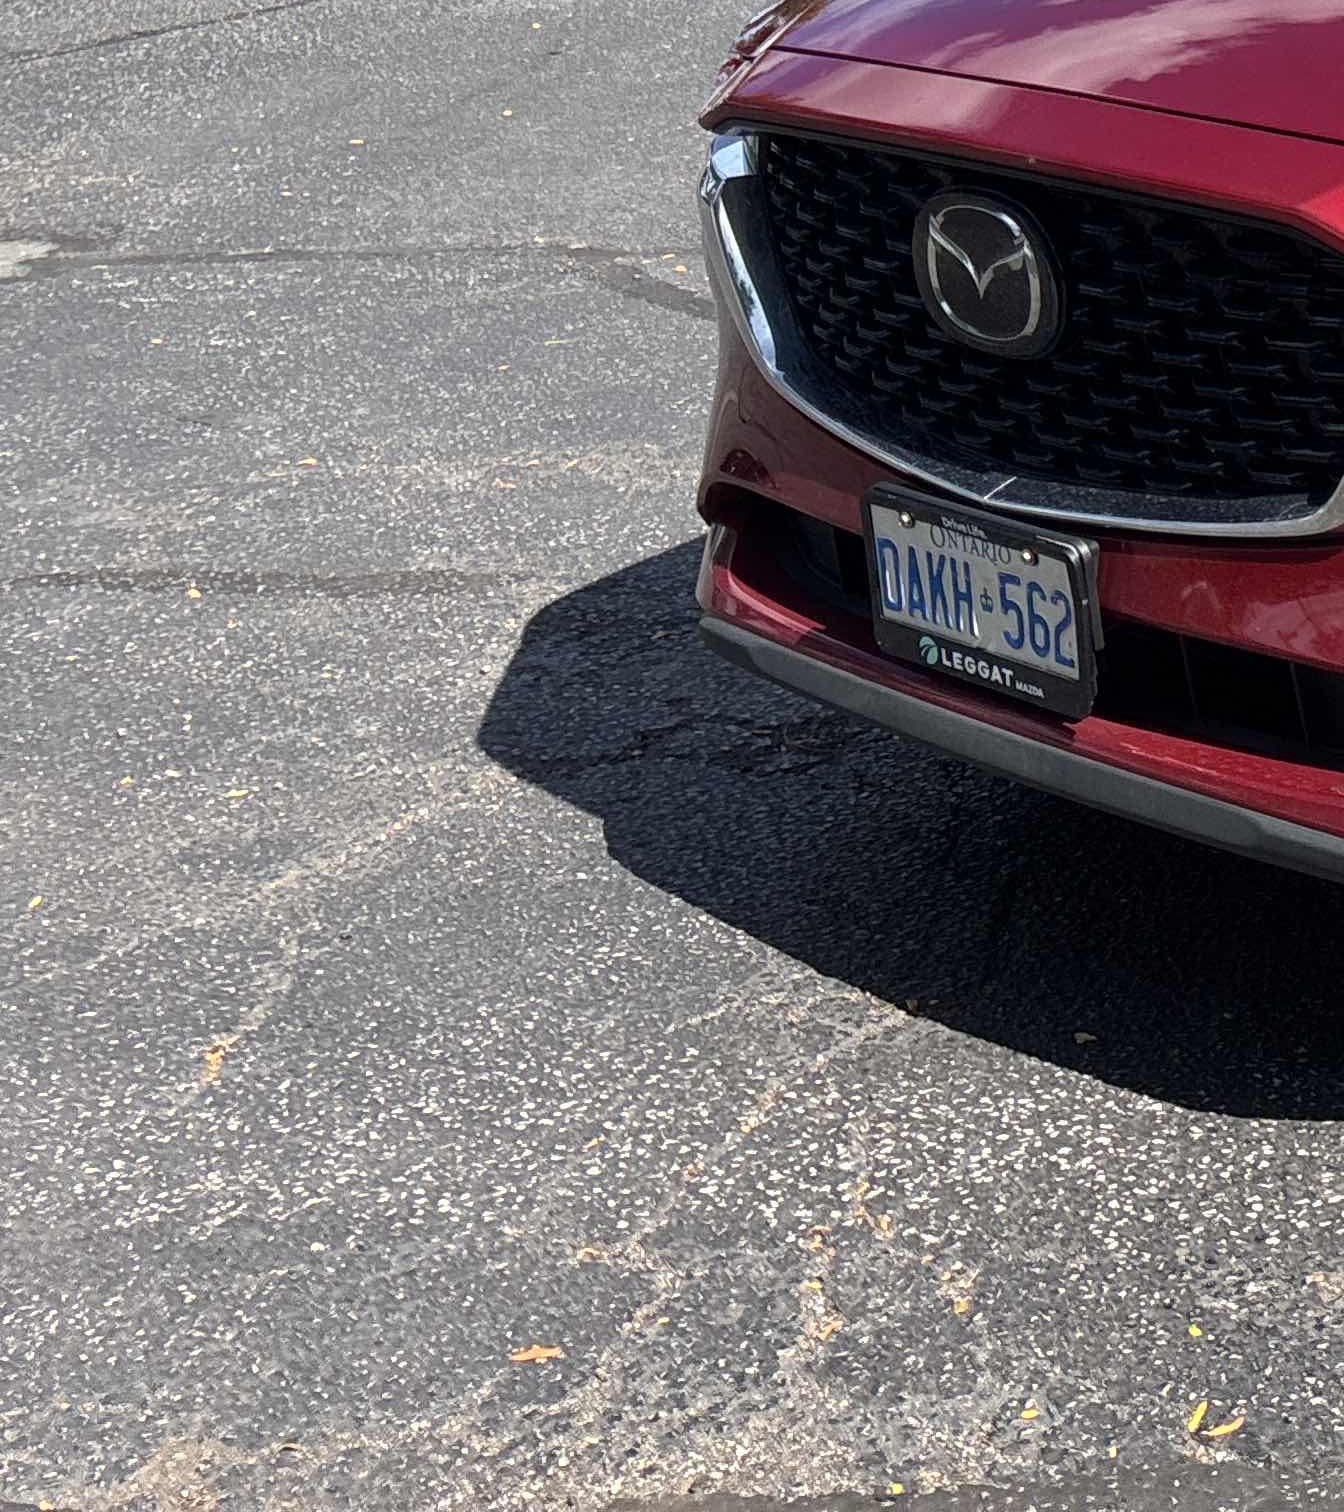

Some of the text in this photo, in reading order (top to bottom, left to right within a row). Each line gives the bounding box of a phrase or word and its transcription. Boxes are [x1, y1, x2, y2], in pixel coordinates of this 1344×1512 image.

[930, 523, 1011, 567] ONTARIO
[941, 645, 1045, 699] LEGGAT MAZDA
